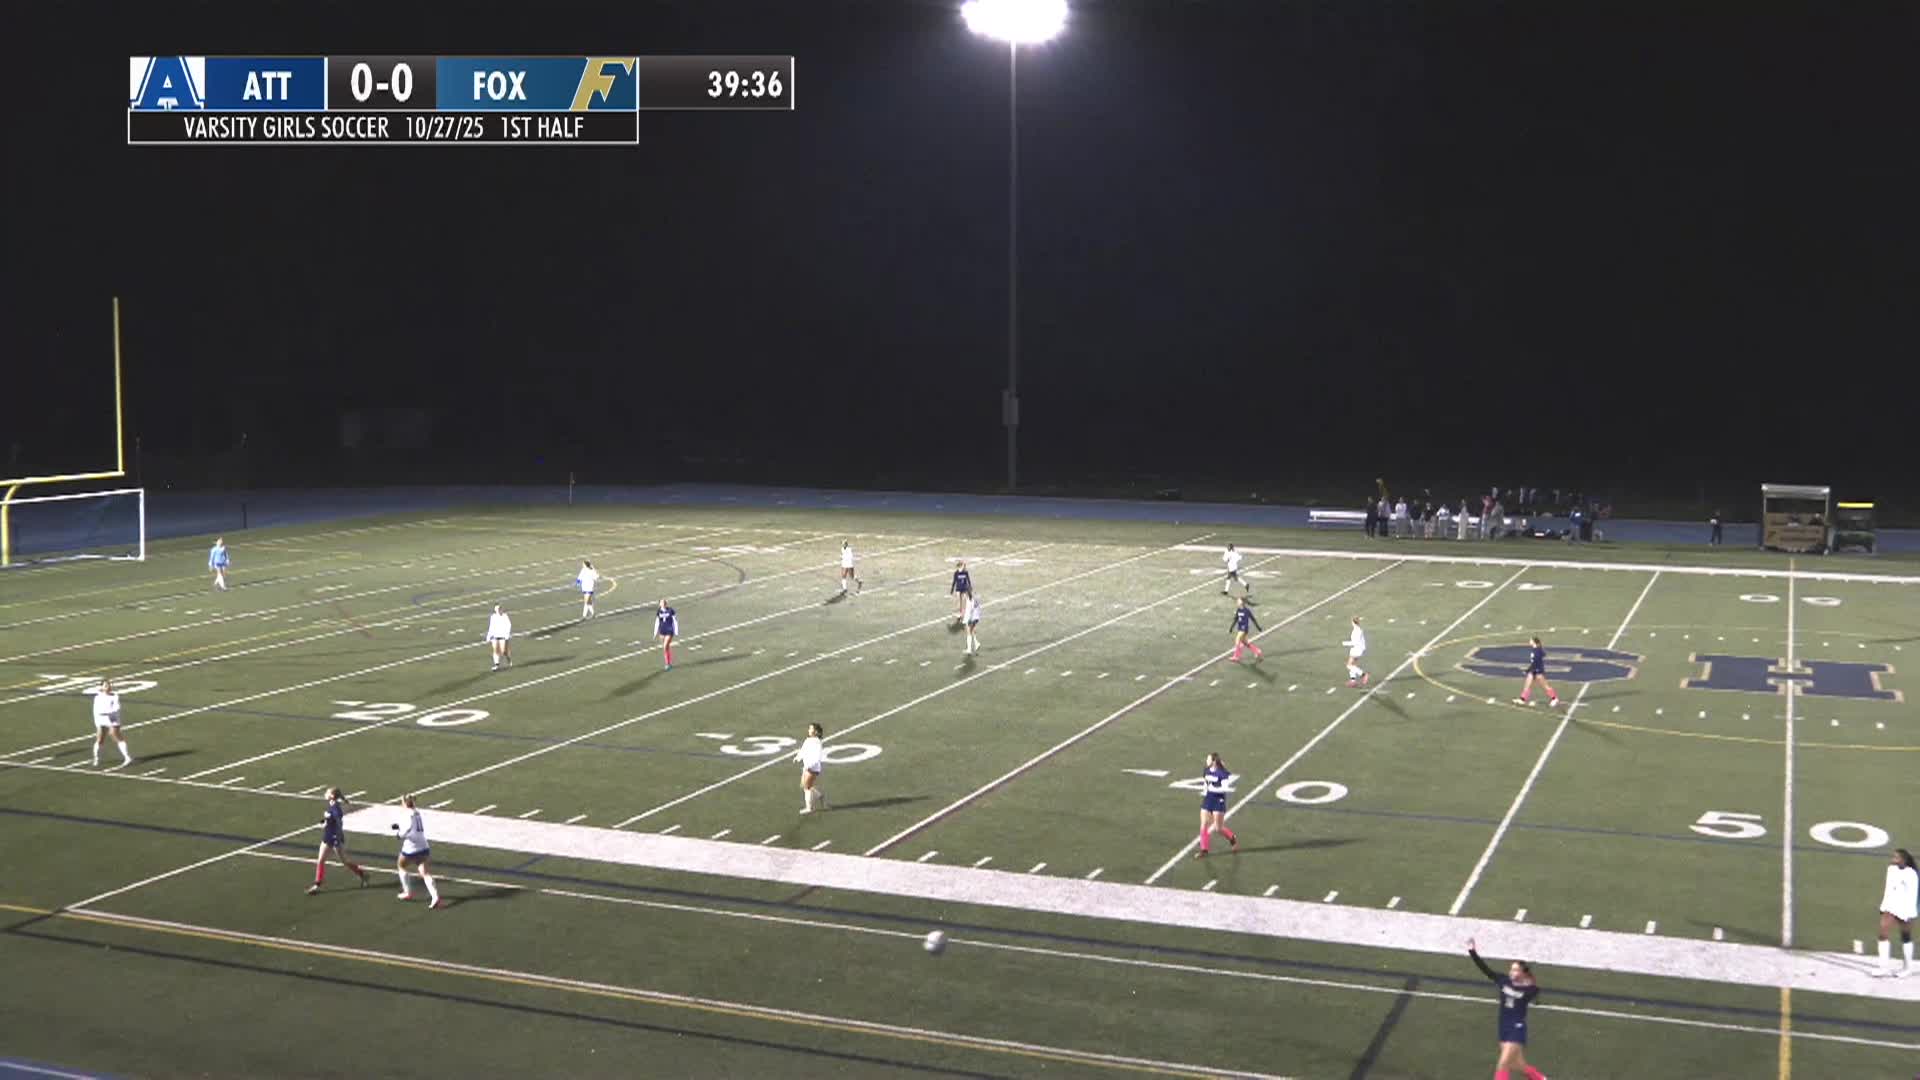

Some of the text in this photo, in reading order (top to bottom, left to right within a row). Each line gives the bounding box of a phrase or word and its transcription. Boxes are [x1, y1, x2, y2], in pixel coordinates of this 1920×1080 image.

[331, 702, 490, 727] 20
[719, 736, 883, 764] 30
[1688, 811, 1890, 849] 50
